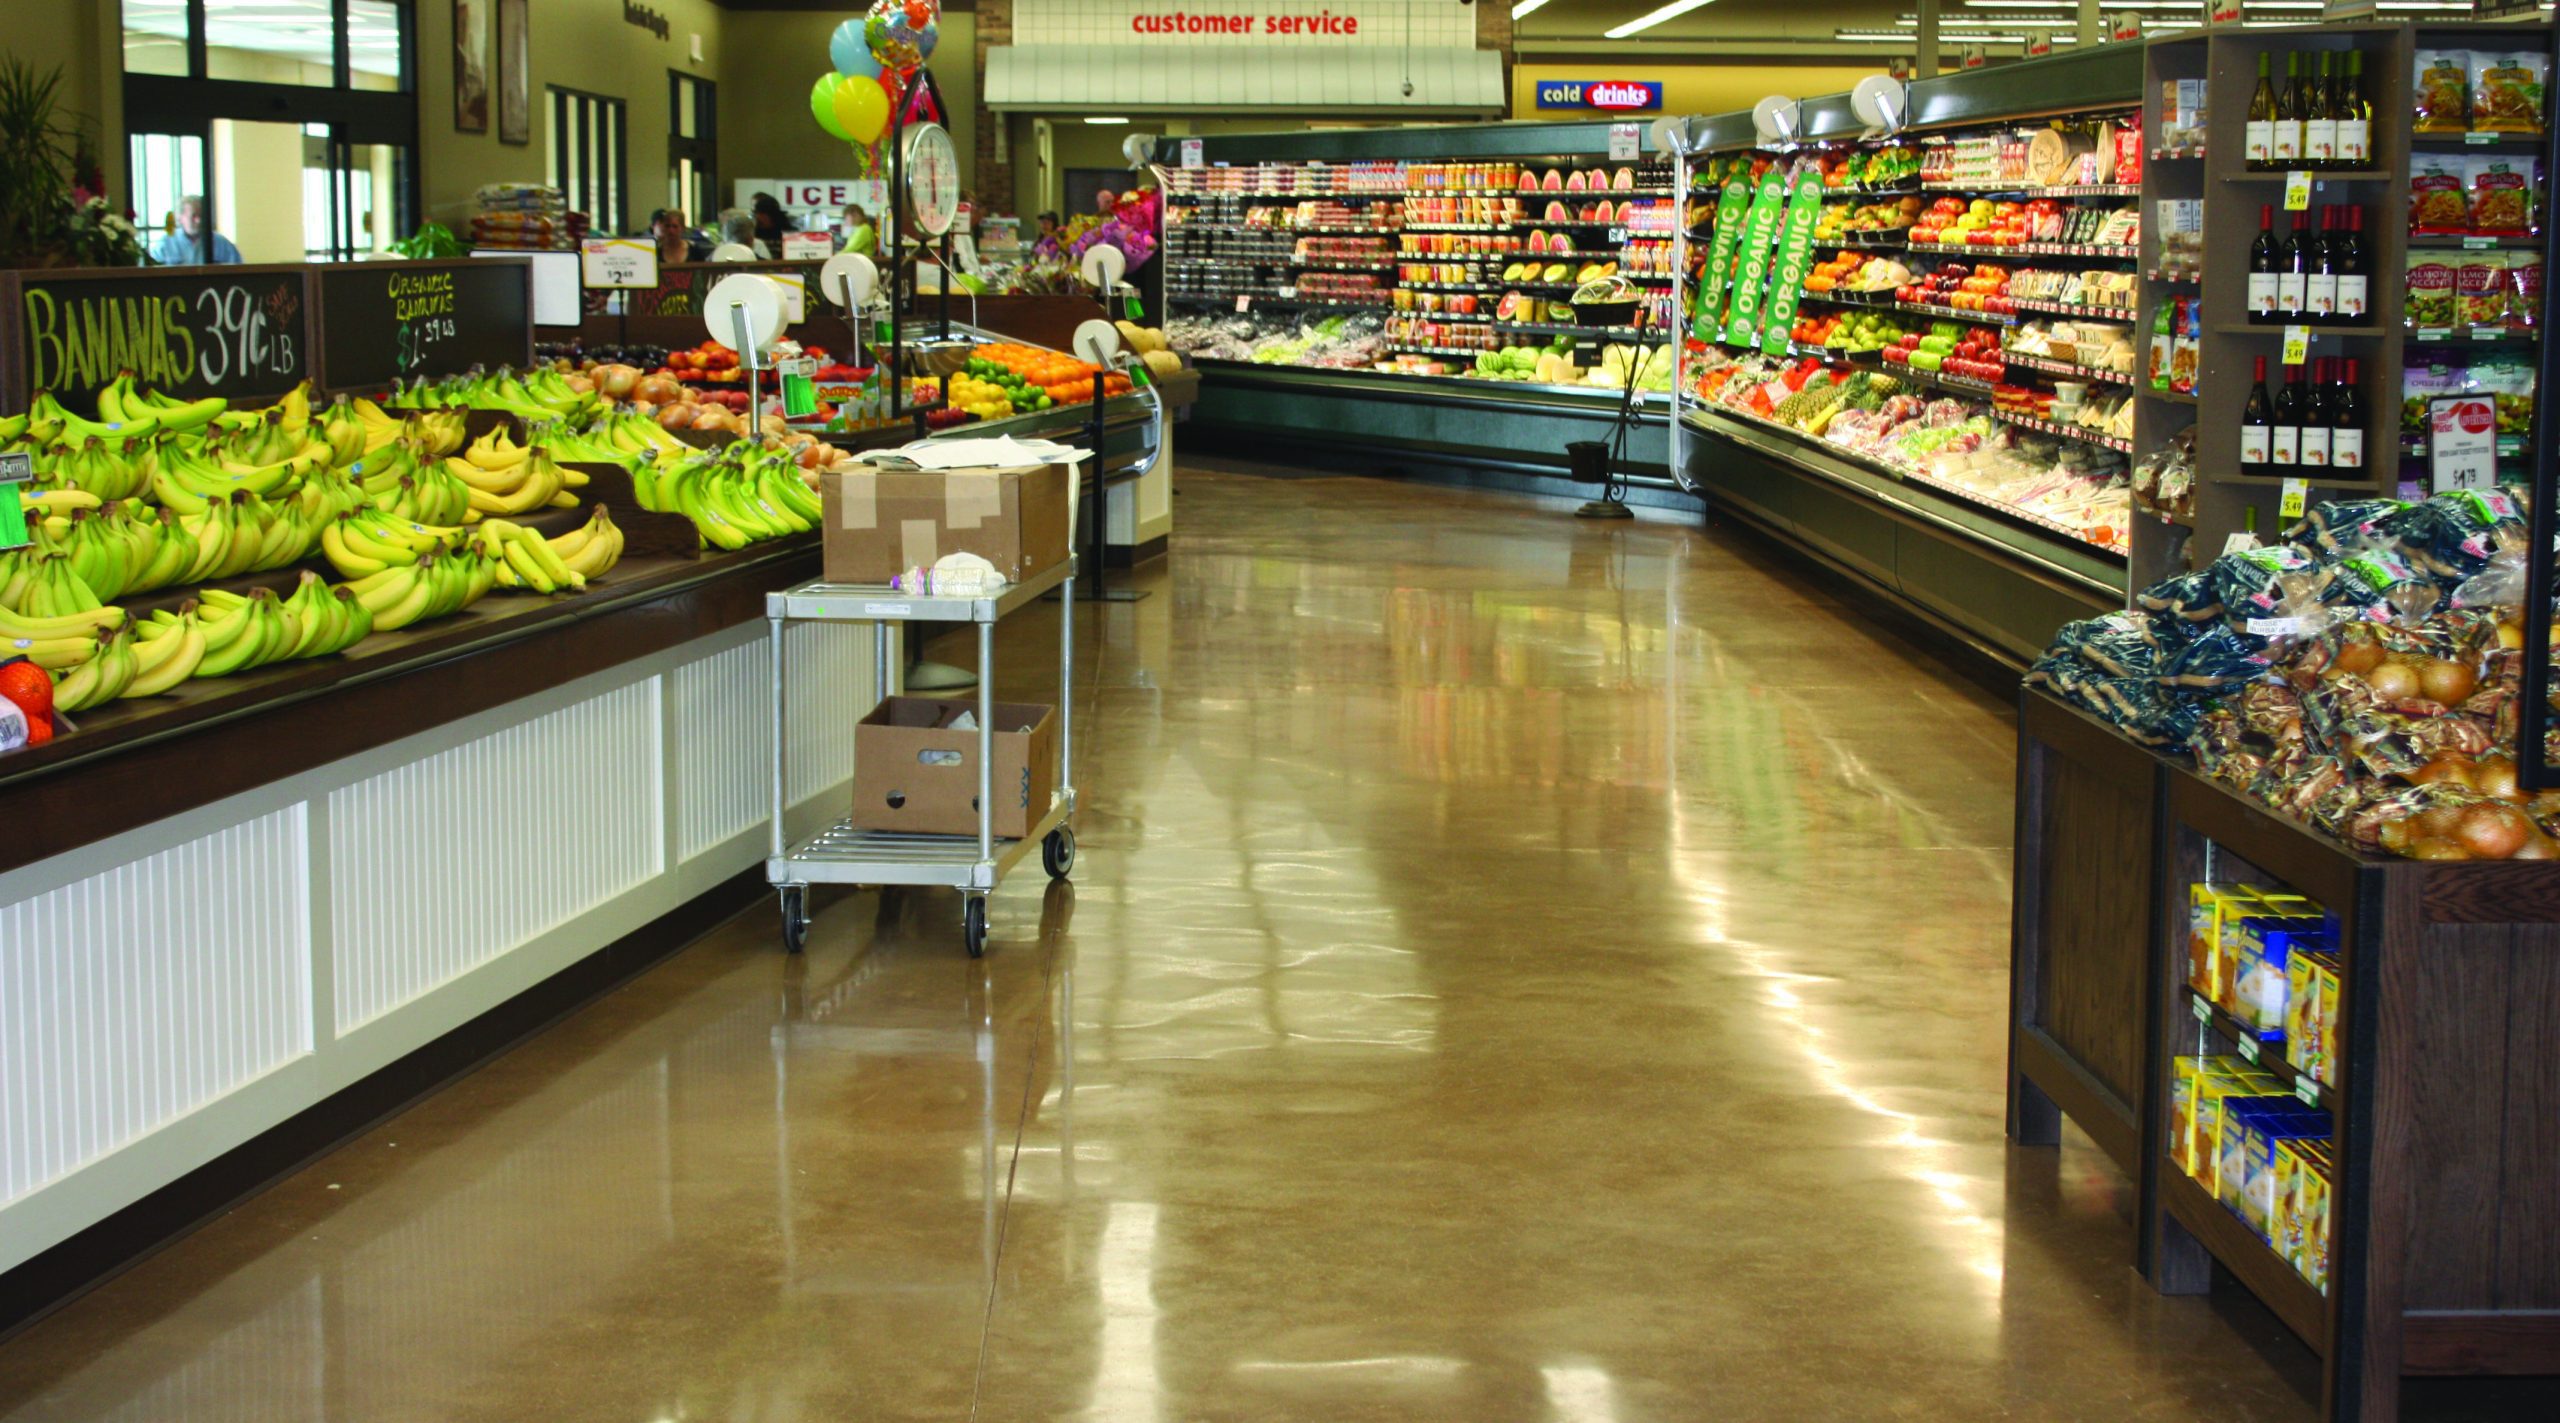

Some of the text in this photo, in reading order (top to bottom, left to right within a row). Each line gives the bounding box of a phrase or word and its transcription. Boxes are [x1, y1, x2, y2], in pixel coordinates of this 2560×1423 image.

[1132, 9, 1358, 34] customer service
[1543, 84, 1647, 106] cold drinks
[785, 186, 847, 206] ICE
[1738, 208, 1774, 314] ORGANIC
[1774, 208, 1812, 321] ORGANIC
[388, 272, 454, 298] ORGANIC
[25, 288, 195, 392] BANANAS
